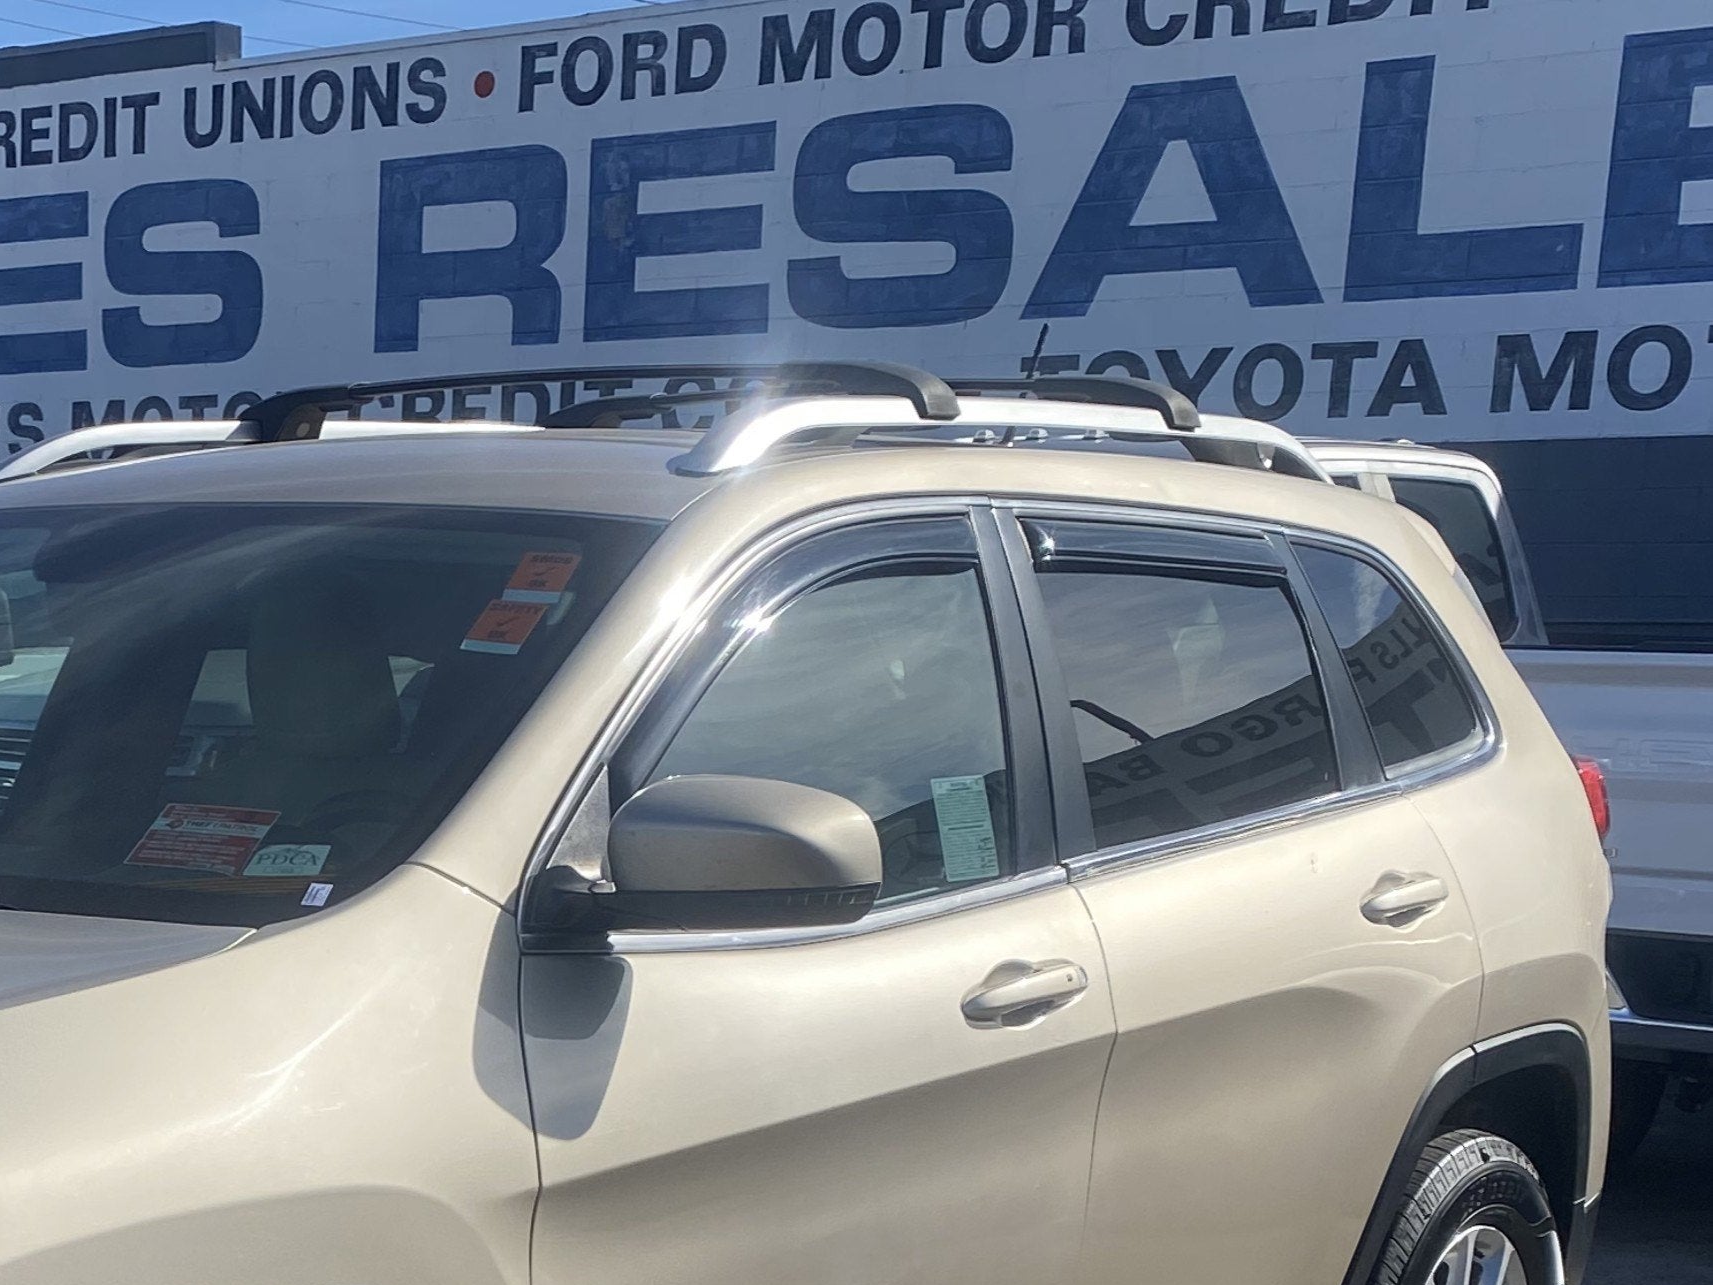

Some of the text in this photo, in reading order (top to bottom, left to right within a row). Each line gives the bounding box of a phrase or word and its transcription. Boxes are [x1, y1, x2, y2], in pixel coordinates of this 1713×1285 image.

[183, 57, 447, 149] UNIONS
[518, 23, 727, 114] FORD
[758, 0, 1086, 86] MOTOR
[255, 851, 322, 867] PDCA
